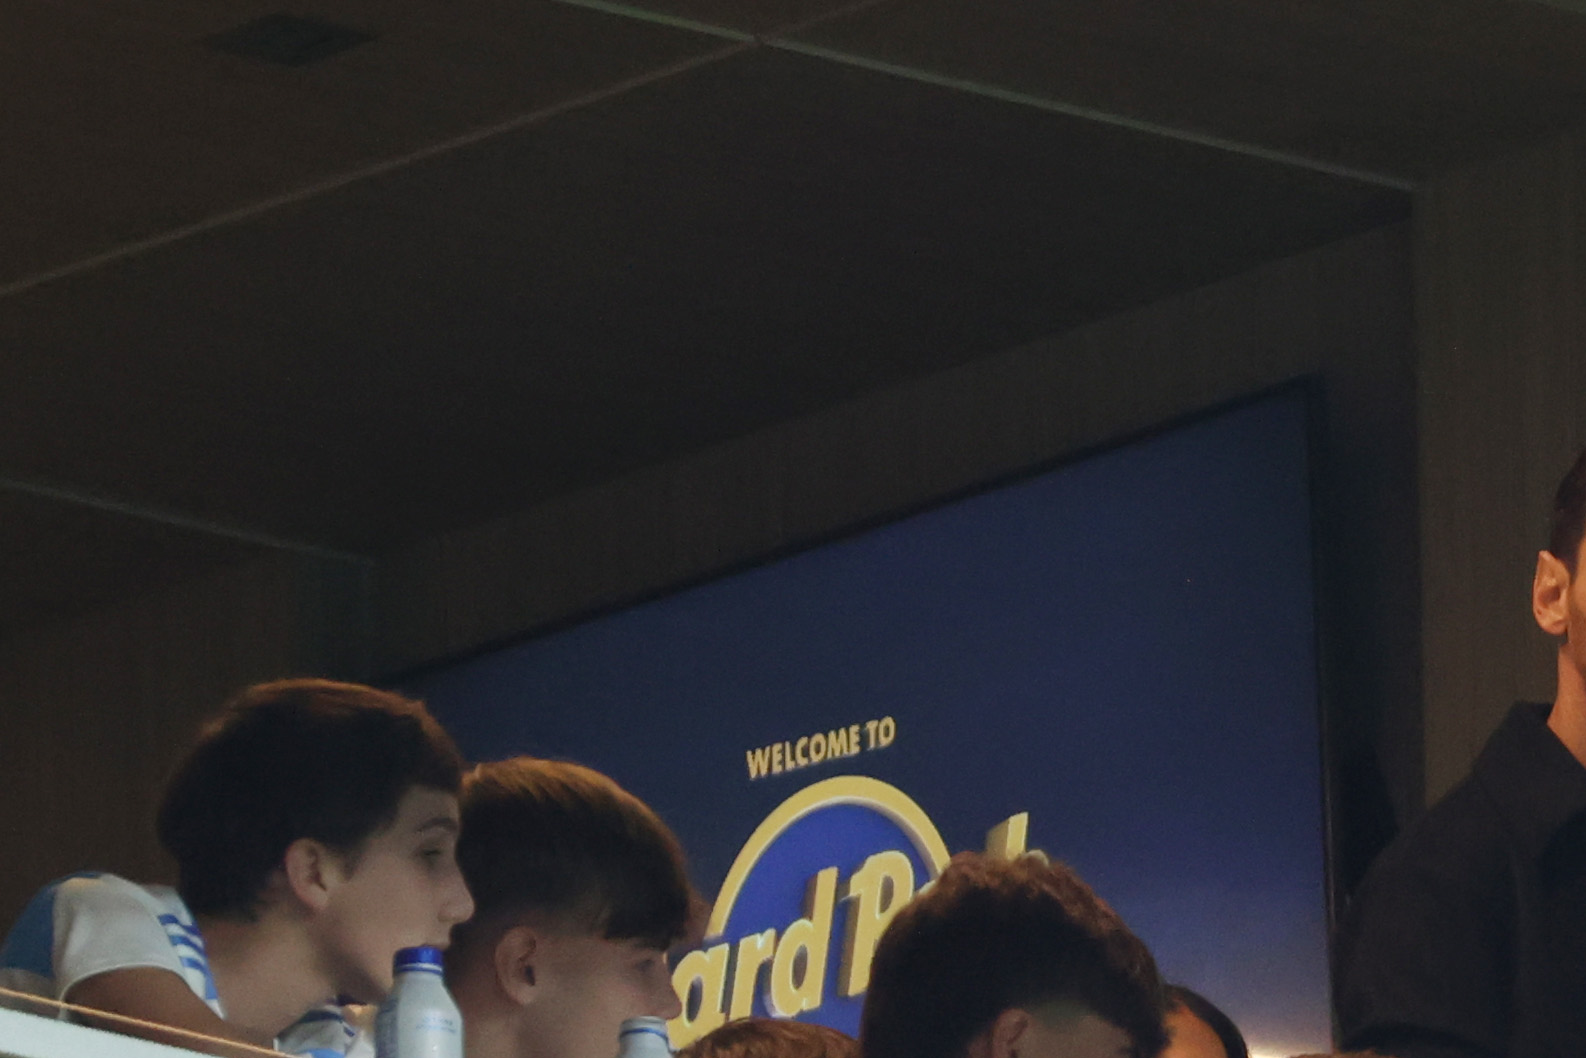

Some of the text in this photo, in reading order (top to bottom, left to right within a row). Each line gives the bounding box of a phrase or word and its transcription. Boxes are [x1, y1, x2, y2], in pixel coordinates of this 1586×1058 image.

[746, 715, 896, 781] WELCOME TO
[667, 866, 839, 1050] ard
